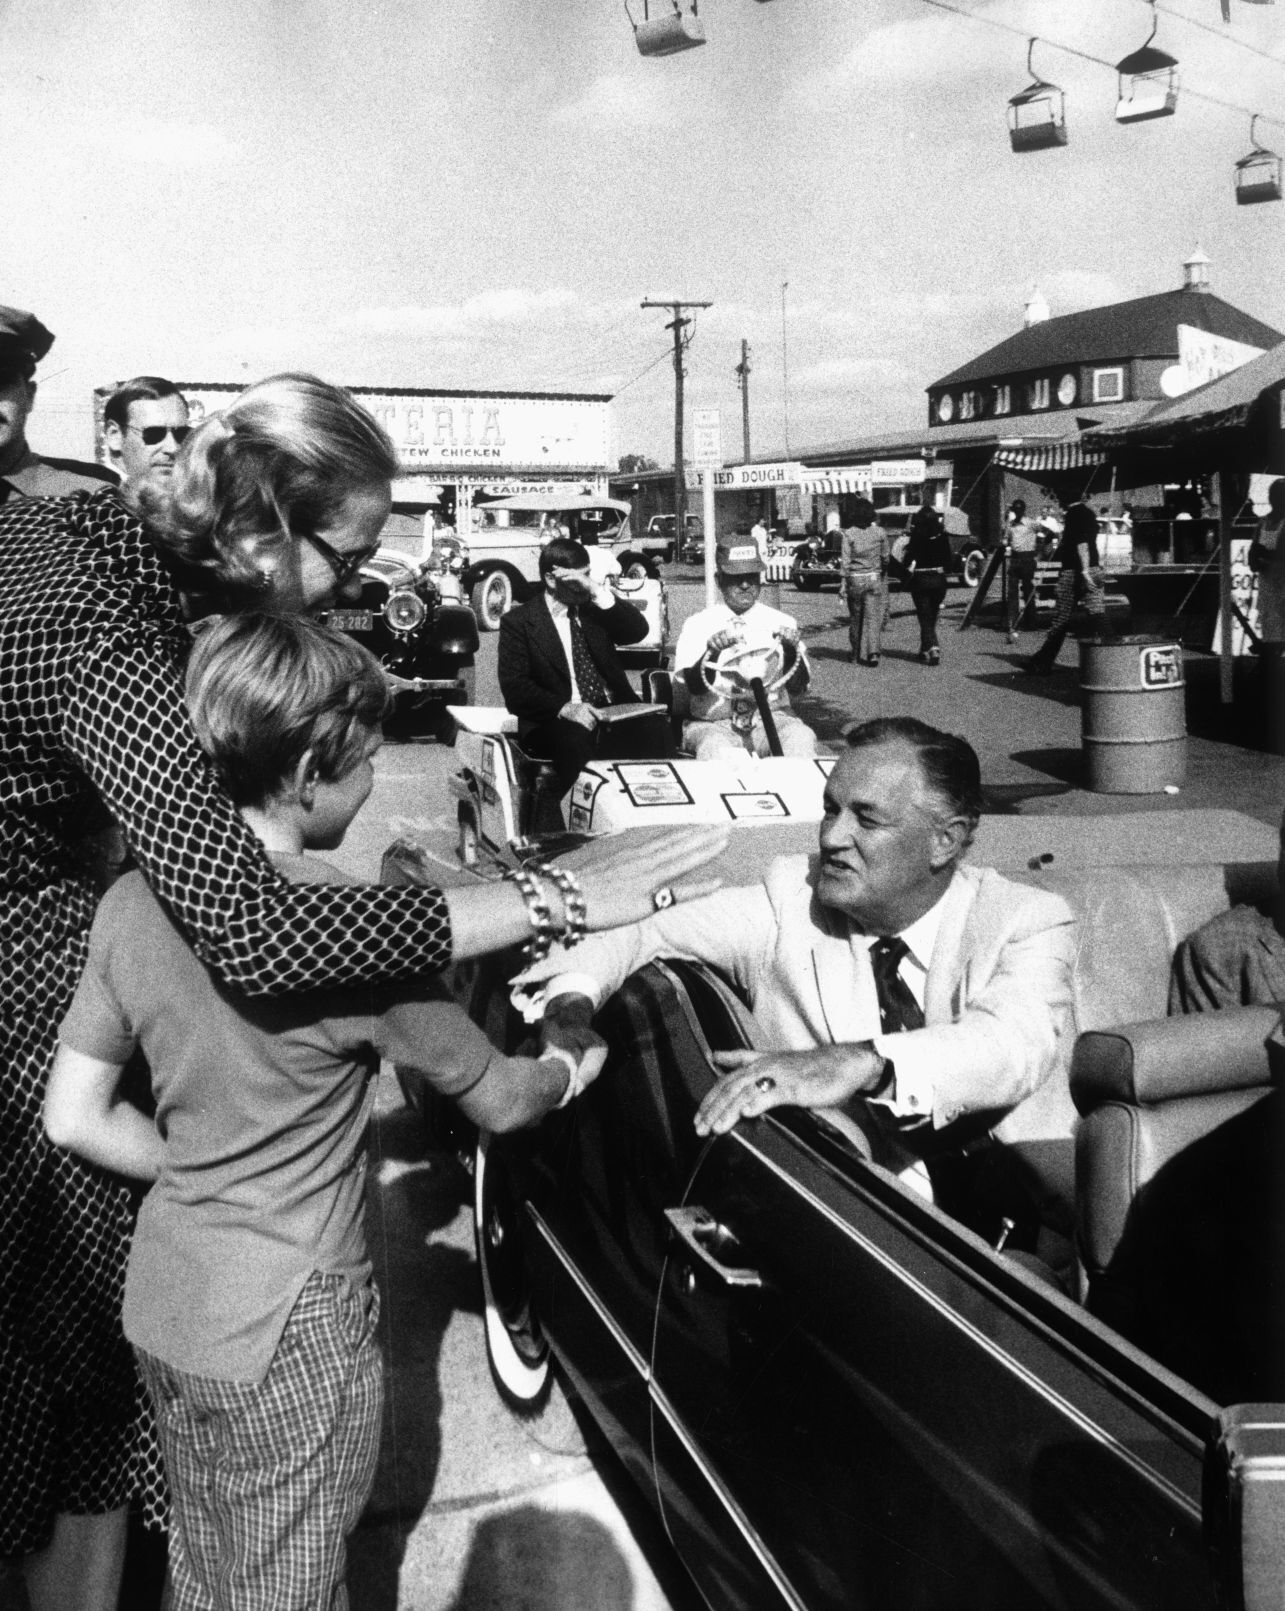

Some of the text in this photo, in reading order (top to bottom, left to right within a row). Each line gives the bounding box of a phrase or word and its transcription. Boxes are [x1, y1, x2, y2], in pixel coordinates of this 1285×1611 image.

[374, 403, 506, 447] TERIA
[401, 447, 501, 458] TEW CHICKEN
[697, 468, 786, 486] FIED DOUGH
[491, 485, 554, 495] SAUSAGE
